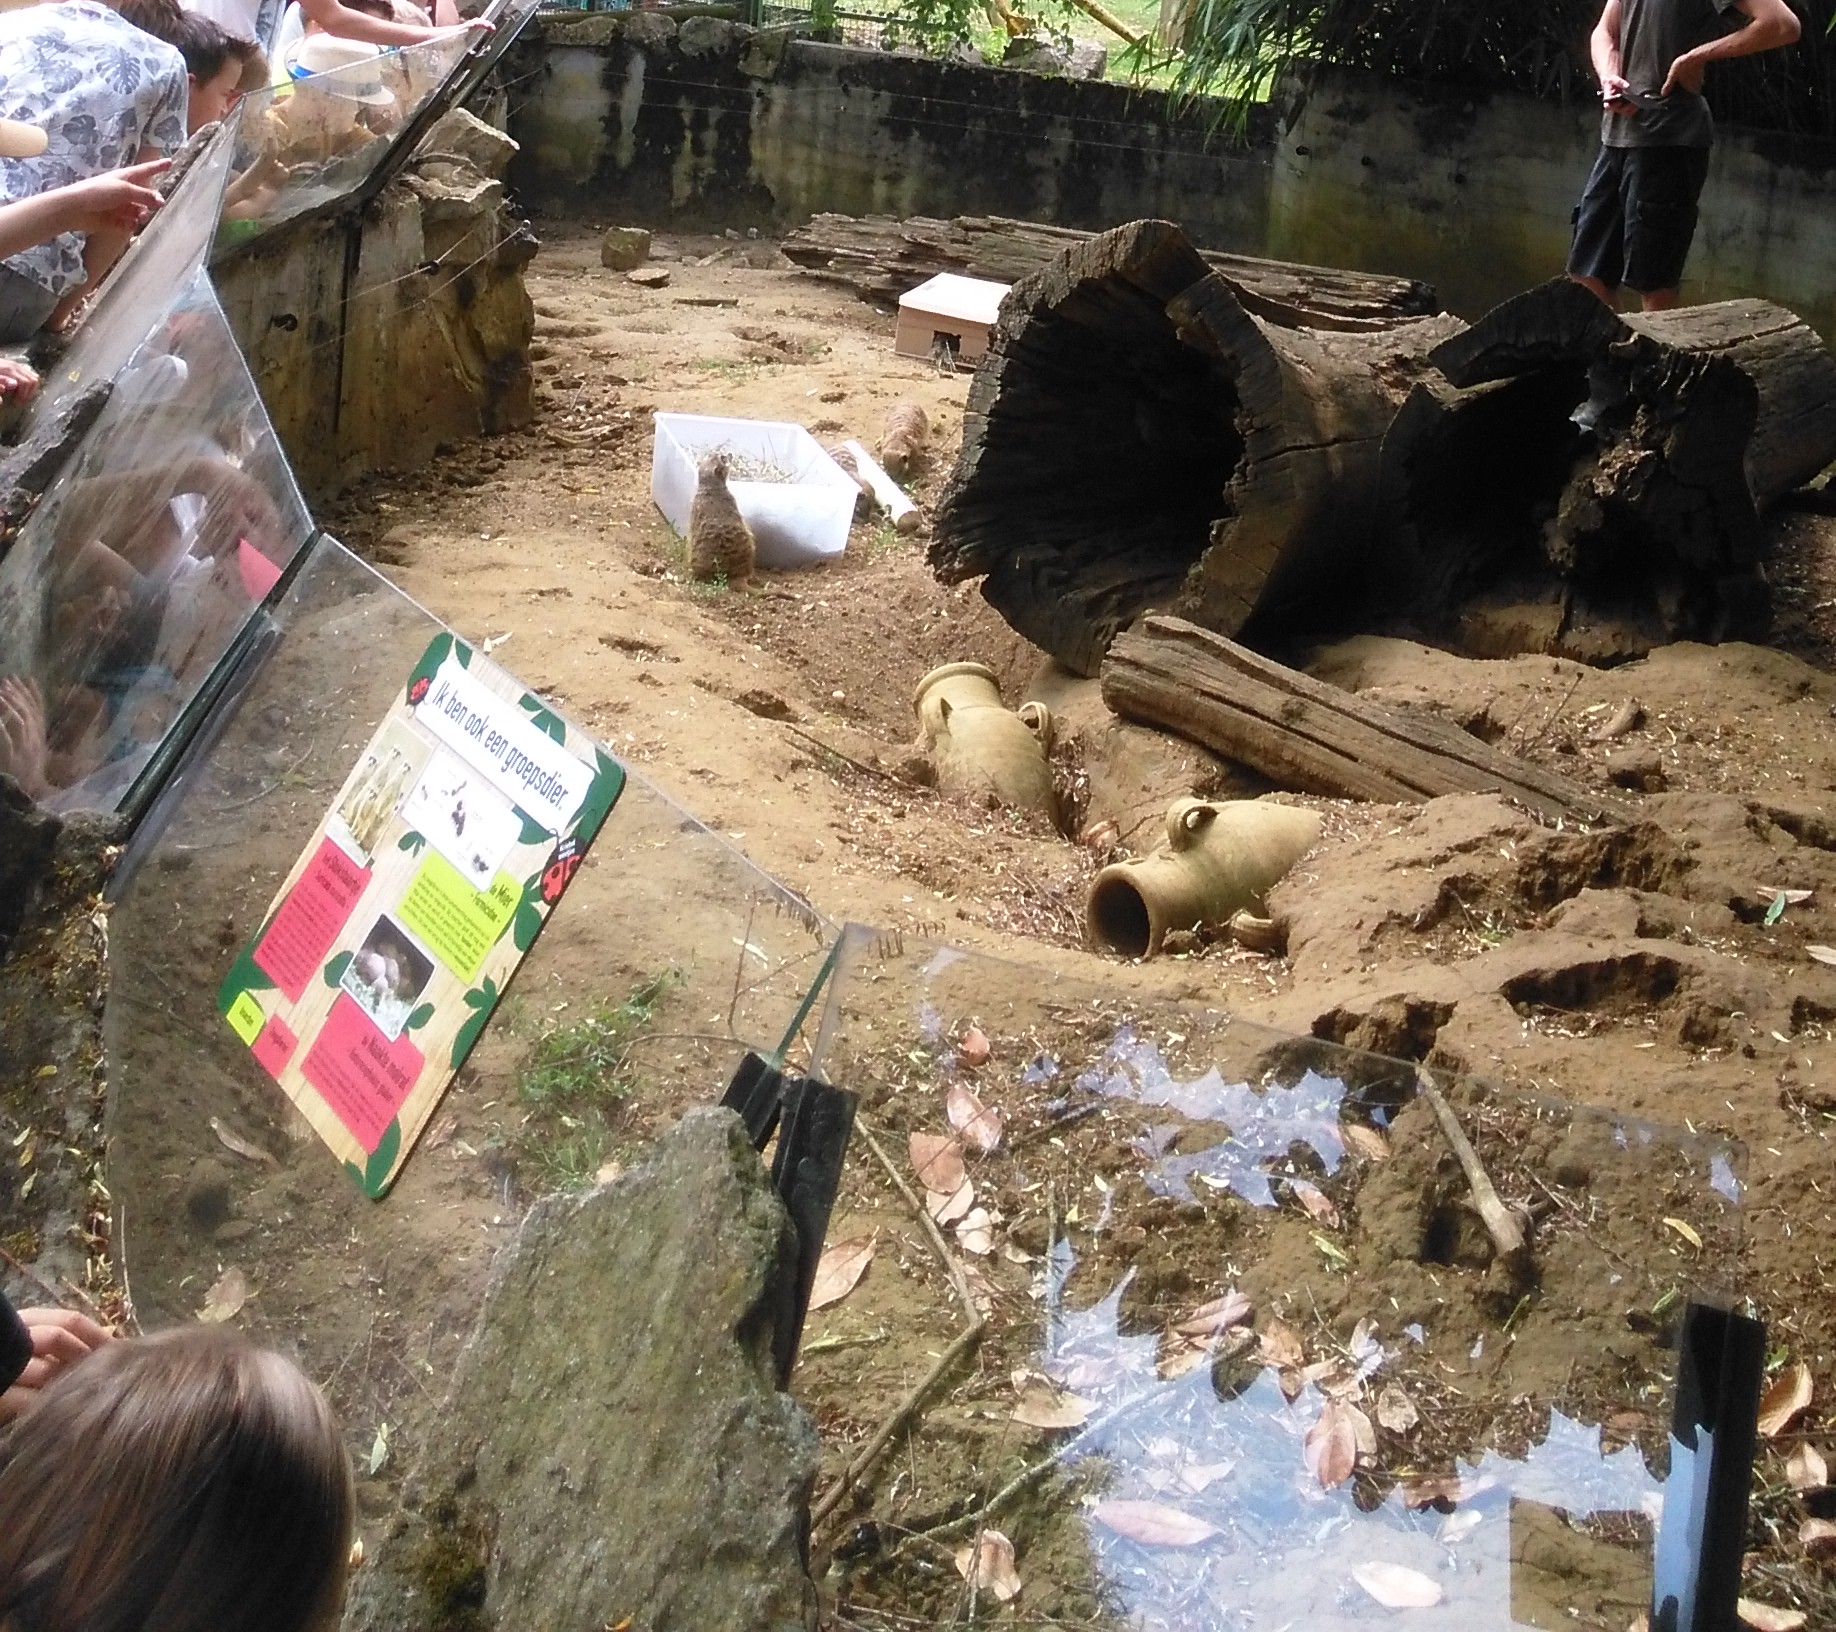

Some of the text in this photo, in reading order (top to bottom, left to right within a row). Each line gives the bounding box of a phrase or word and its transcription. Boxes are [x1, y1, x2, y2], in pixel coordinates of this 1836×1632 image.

[432, 680, 568, 811] Ik ben ook een groepsdier.
[495, 884, 514, 908] Mier
